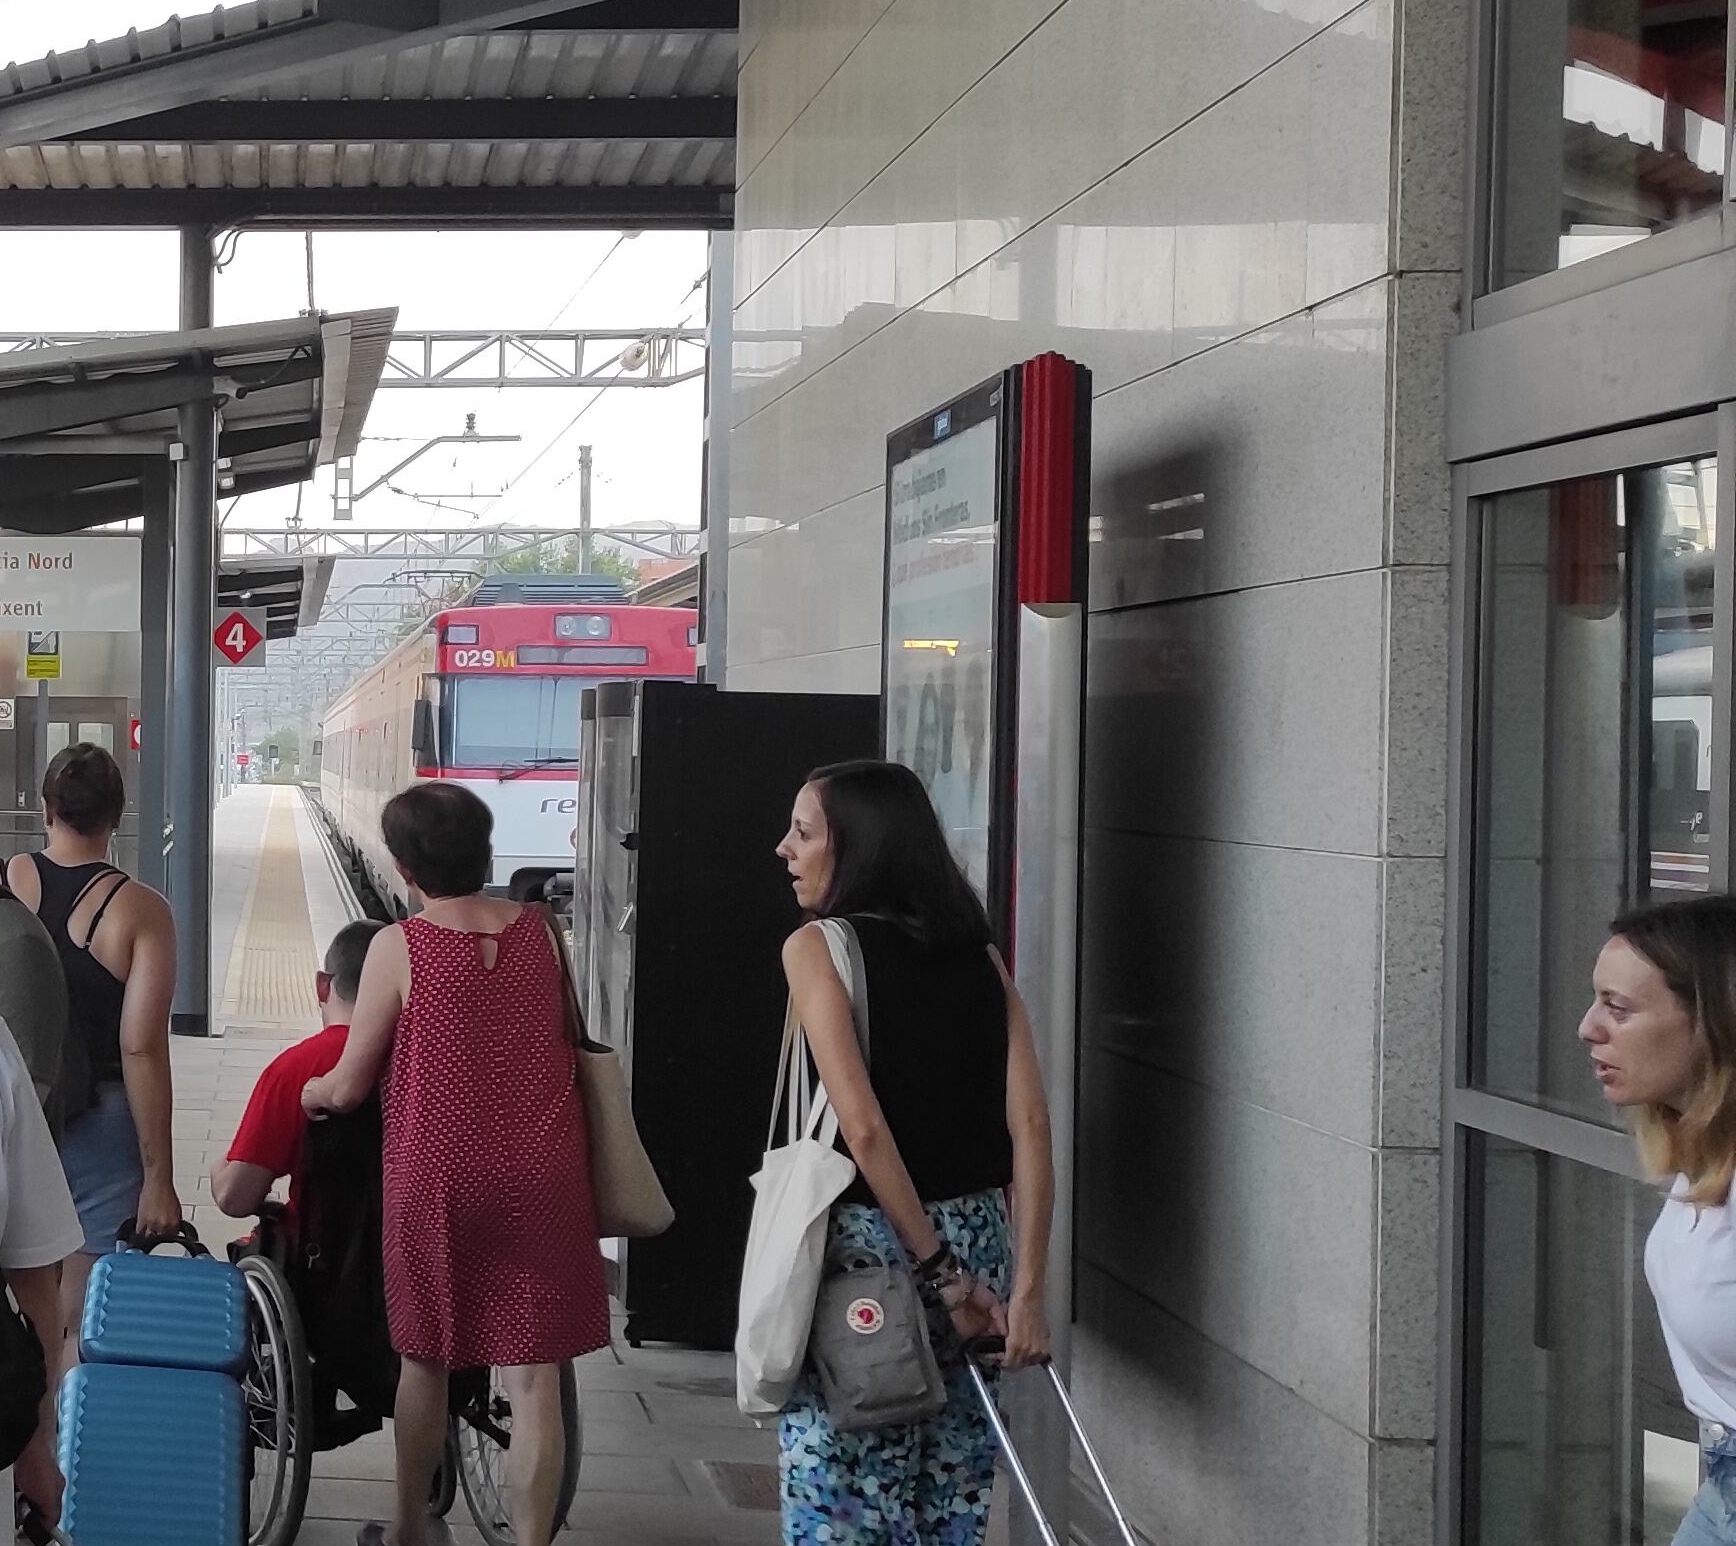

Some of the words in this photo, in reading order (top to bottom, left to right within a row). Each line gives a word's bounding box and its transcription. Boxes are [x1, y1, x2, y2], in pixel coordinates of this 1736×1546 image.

[28, 551, 73, 570] Nord
[225, 622, 247, 653] 4
[454, 649, 516, 668] 029M
